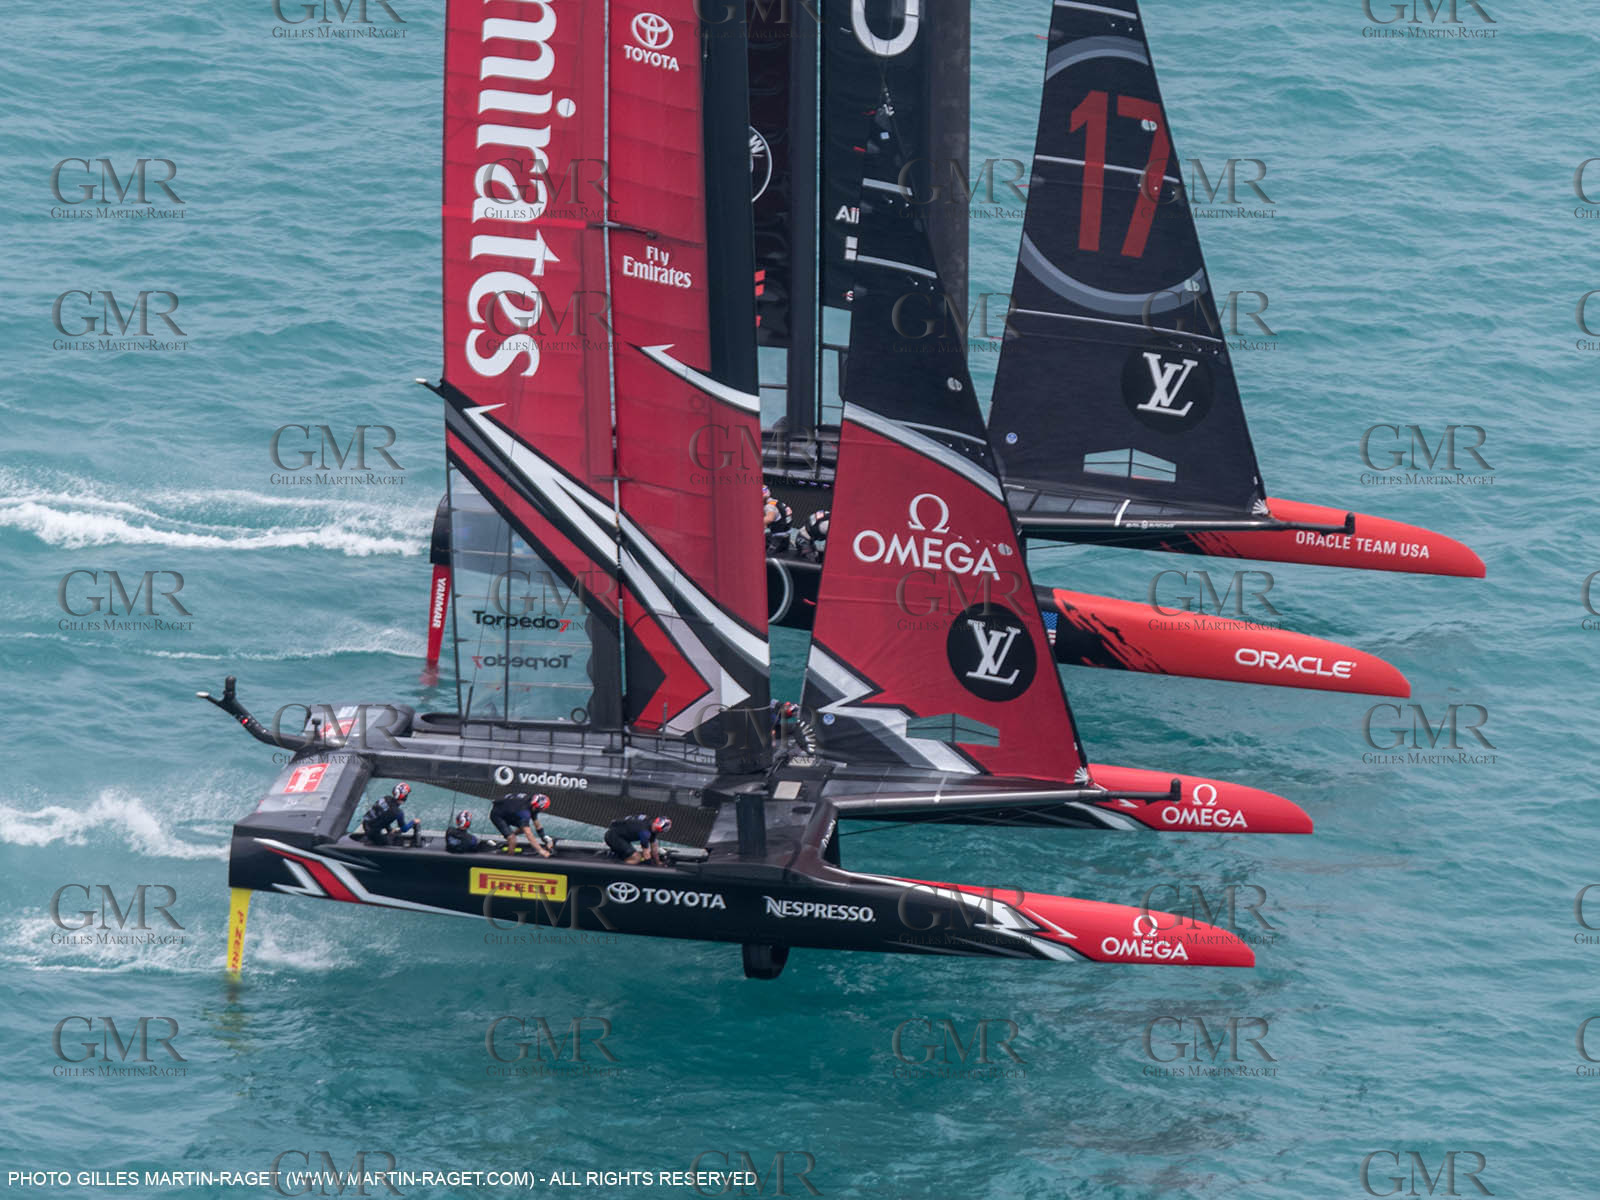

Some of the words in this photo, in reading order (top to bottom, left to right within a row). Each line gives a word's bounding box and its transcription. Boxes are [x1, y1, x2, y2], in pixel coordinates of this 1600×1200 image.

[624, 45, 680, 71] TOYOTA
[1069, 90, 1170, 258] 17
[646, 246, 669, 266] Fly
[623, 256, 692, 288] Emirates
[853, 530, 1000, 581] OMEGA
[1295, 530, 1351, 550] ORACLE
[1356, 537, 1397, 555] TEAM
[1400, 543, 1430, 559] USA
[432, 577, 447, 629] YANMAR
[472, 610, 571, 632] Torpedo7
[519, 771, 588, 789] vodafone
[1161, 806, 1248, 828] OMEGA
[479, 872, 559, 896] PIRELLI
[642, 887, 726, 910] TOYOTA
[1101, 937, 1189, 960] OMEGA
